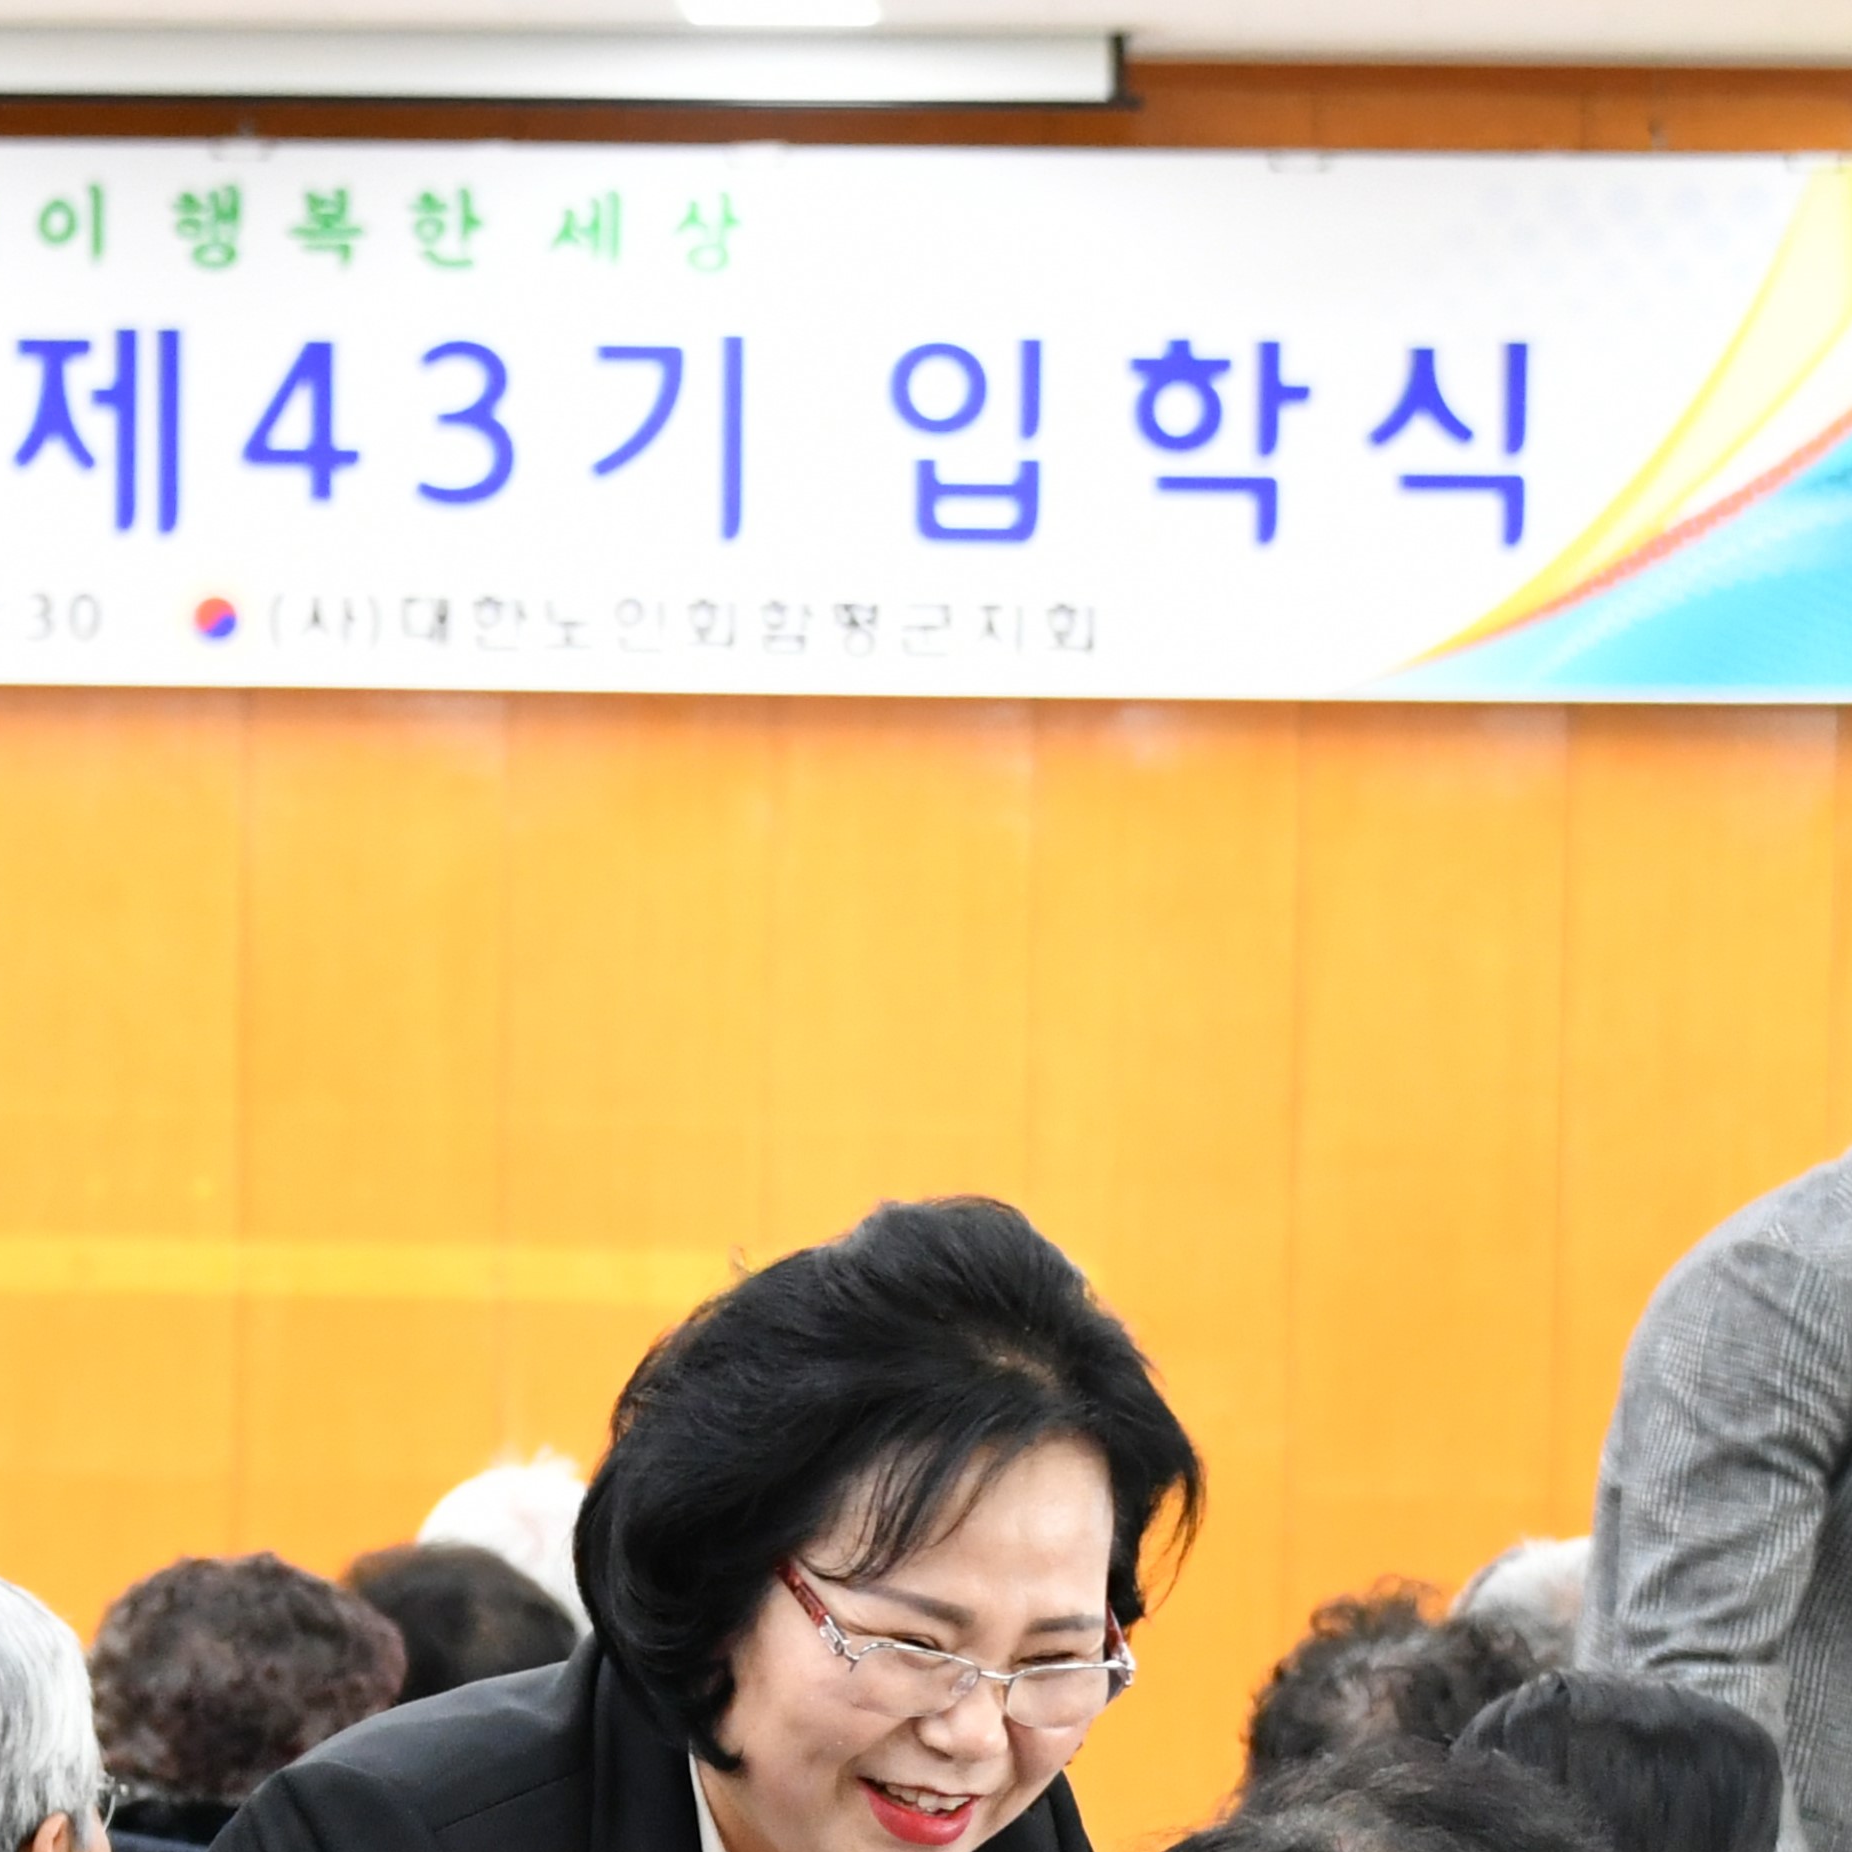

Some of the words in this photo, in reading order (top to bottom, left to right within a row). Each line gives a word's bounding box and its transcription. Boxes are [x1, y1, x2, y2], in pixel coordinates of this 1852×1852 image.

[170, 181, 484, 271] 행복한
[551, 189, 740, 273] 세상
[12, 326, 744, 541] 제43기
[887, 337, 1532, 548] 입학식
